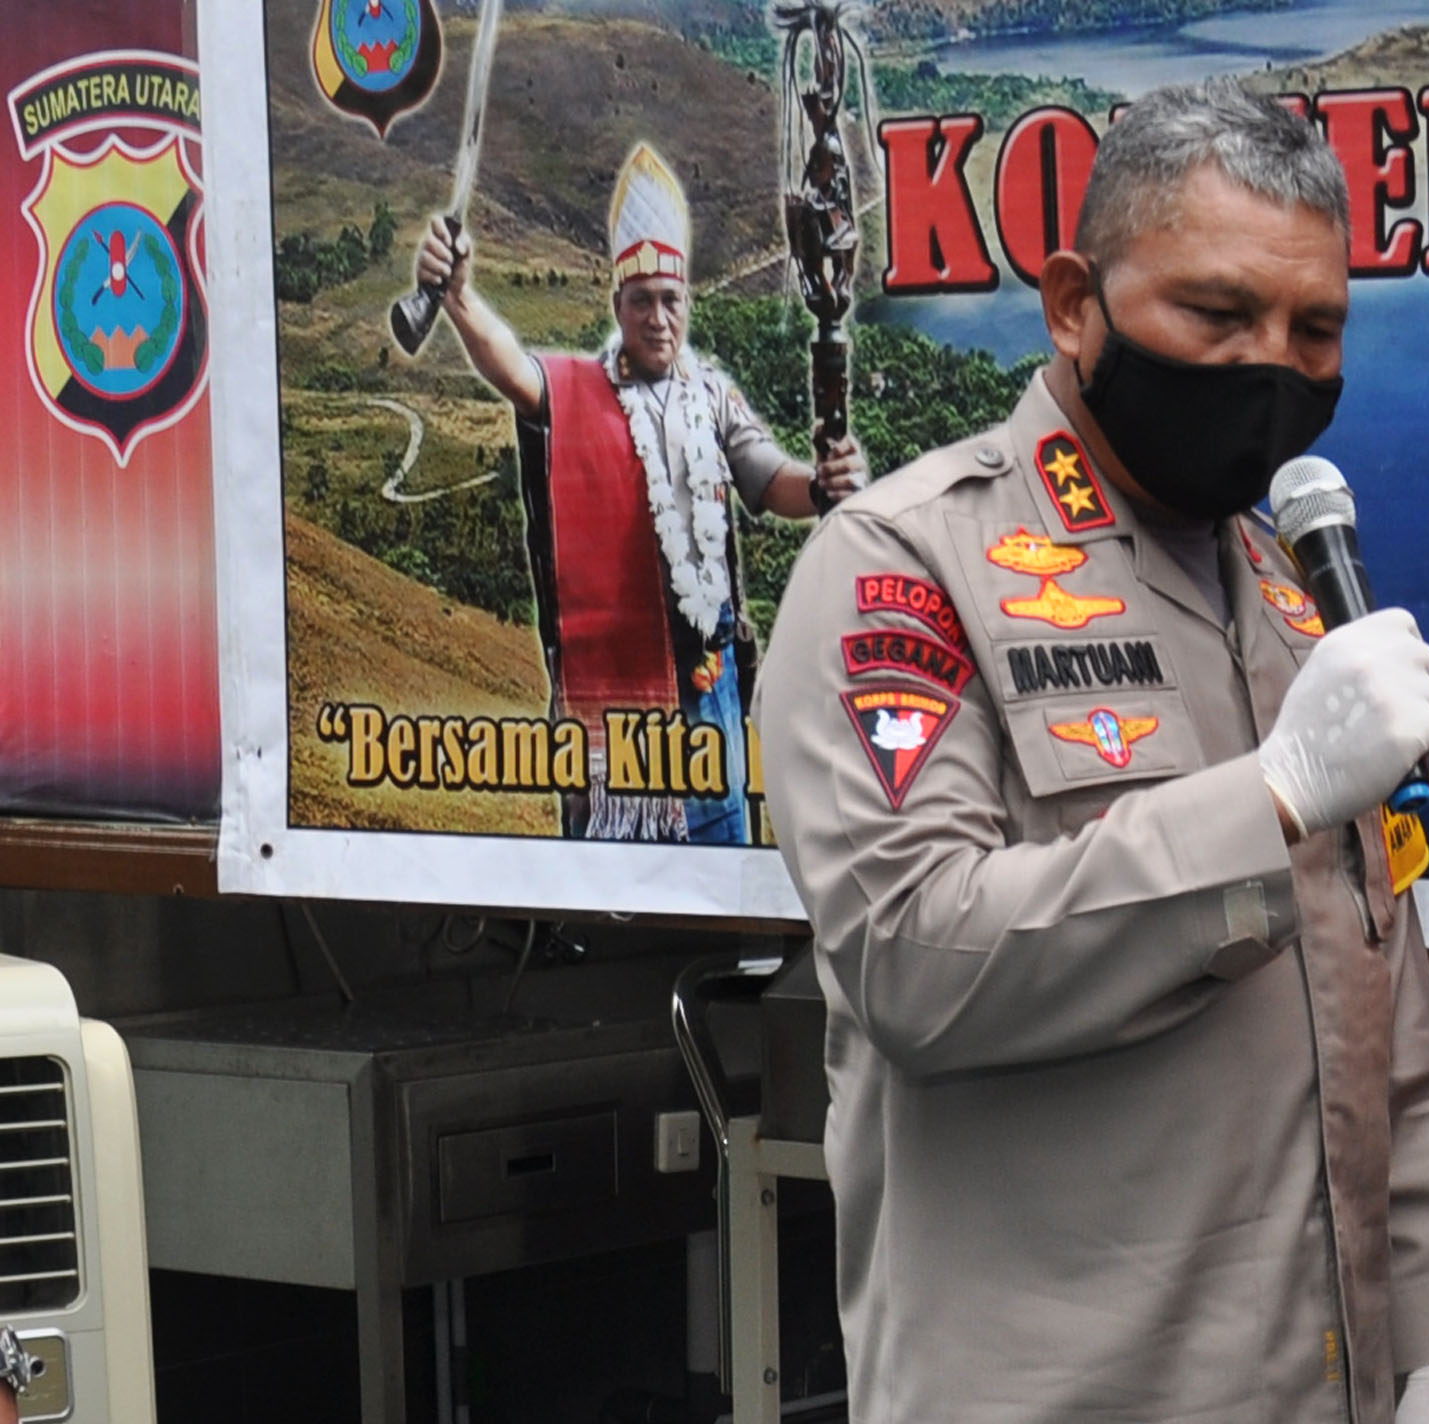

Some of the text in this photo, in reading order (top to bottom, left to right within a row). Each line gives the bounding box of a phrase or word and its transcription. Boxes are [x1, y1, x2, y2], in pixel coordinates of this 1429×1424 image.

[23, 73, 201, 136] SUMATERA UTARA
[853, 635, 962, 690] GEGANA
[602, 708, 730, 798] Kita
